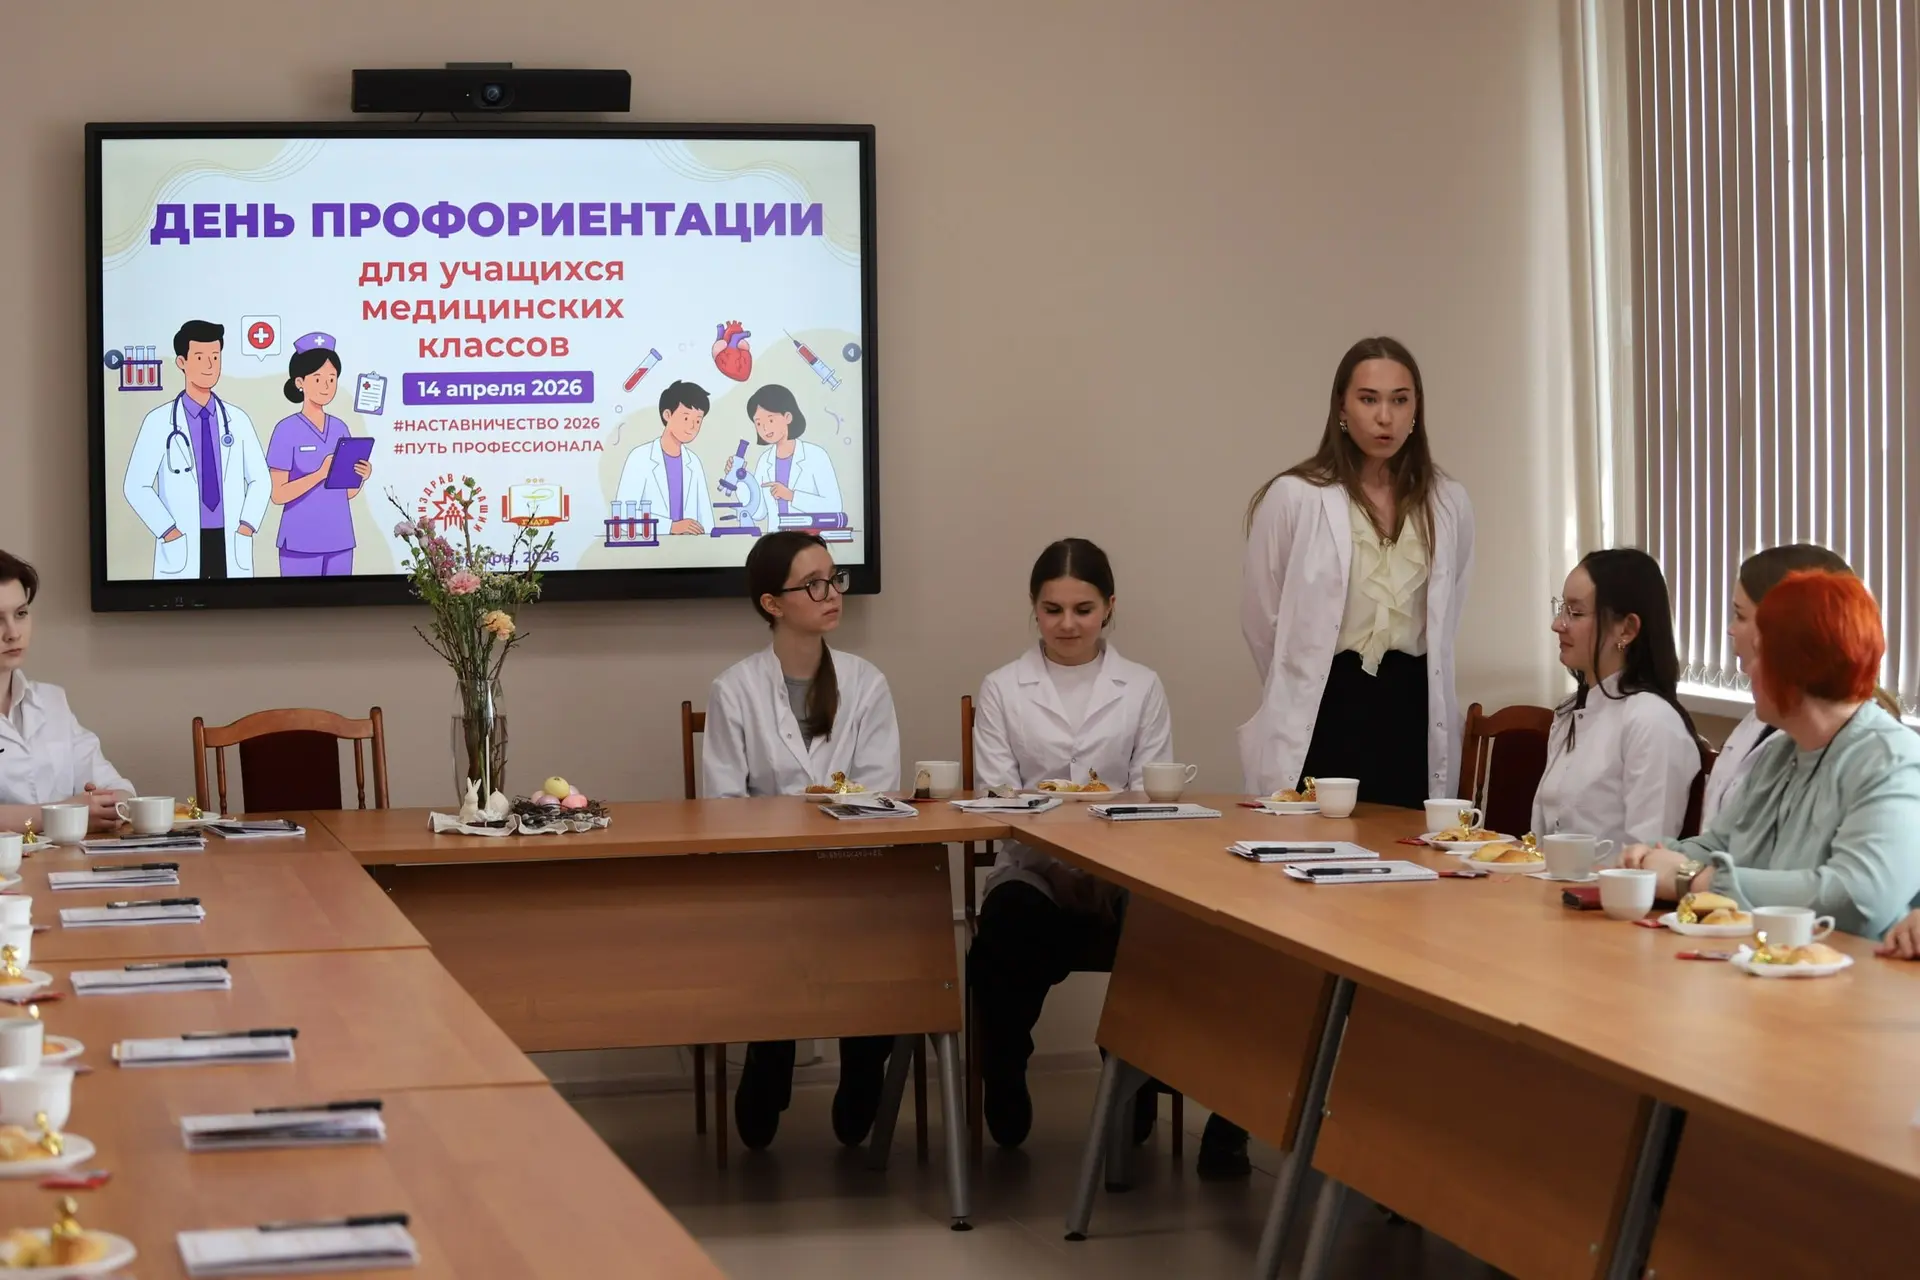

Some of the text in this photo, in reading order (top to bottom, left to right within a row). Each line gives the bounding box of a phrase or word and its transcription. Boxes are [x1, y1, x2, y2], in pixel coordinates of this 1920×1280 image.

[150, 200, 824, 246] ДЕНЬ ПРОФОРИЕНТАЦИИ
[358, 259, 625, 290] для учащихся
[362, 297, 625, 325] медицинских
[418, 335, 571, 359] классов
[417, 378, 583, 401] 14 апреля 2026
[393, 417, 600, 432] #НАСТАВНИЧЕСТВО 2026
[393, 439, 604, 455] #ПУТЬ ПРОФЕССИОНАЛА
[417, 473, 454, 521] НЗДРАВ
[523, 550, 560, 563] 2026
